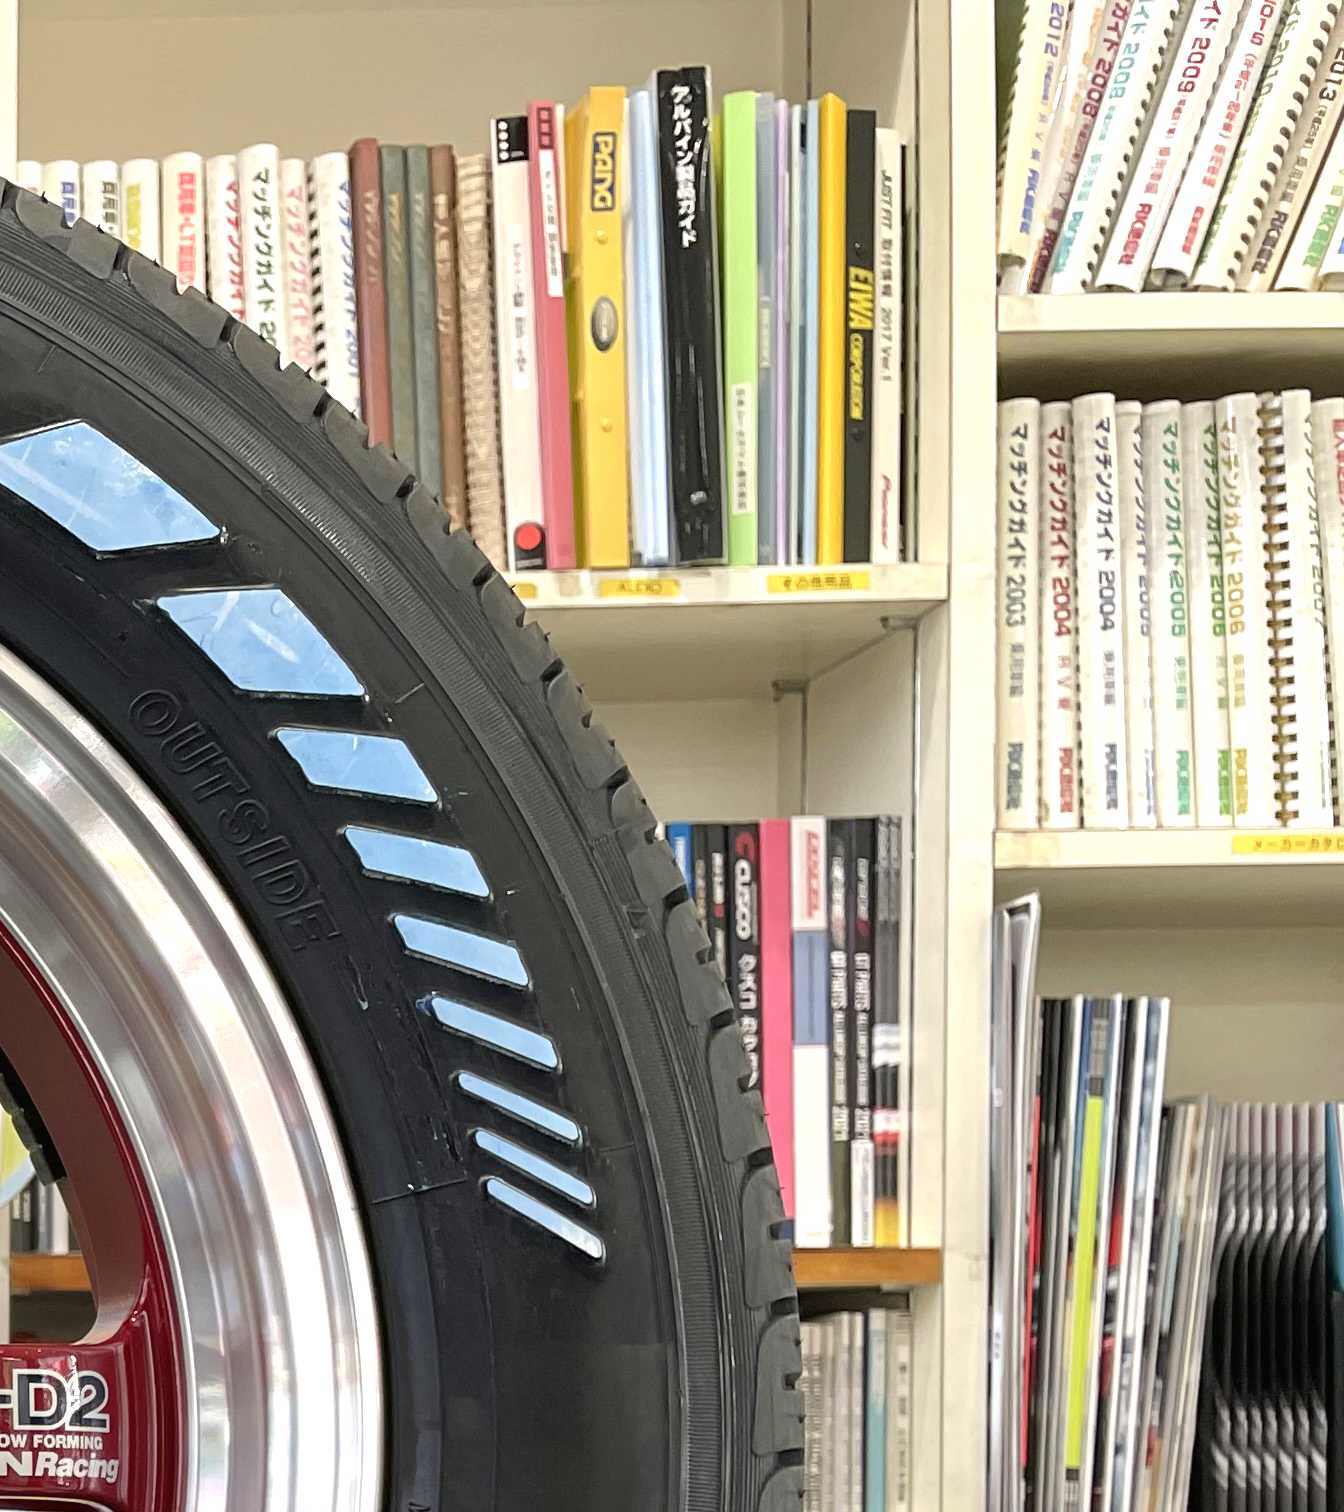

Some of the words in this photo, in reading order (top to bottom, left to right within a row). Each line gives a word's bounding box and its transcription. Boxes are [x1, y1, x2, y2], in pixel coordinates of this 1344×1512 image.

[1250, 0, 1276, 46] 015
[850, 267, 874, 329] EIWA
[1005, 575, 1026, 627] 2003
[1051, 576, 1071, 638] 2004
[1099, 571, 1117, 632] 2004
[129, 690, 343, 953] OUTSIDE
[33, 1434, 104, 1450] FORMING
[35, 1450, 120, 1483] Racing
